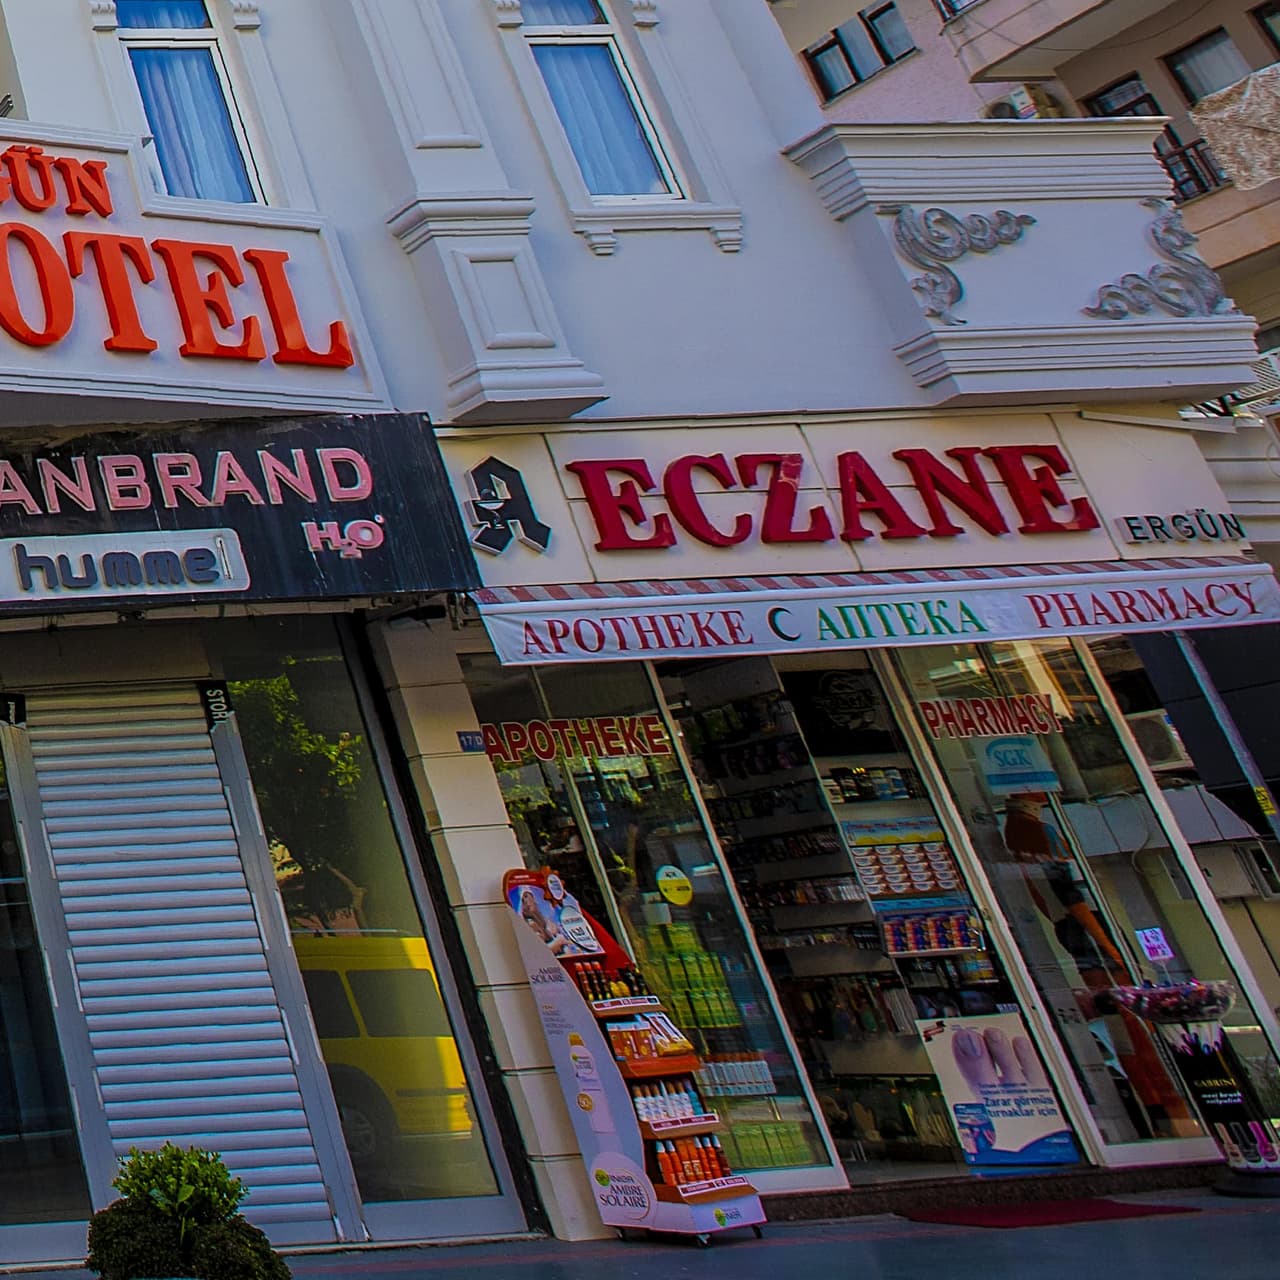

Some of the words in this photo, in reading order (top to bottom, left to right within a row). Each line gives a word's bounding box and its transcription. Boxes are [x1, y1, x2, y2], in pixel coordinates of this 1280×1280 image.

[565, 444, 1100, 552] ECZANE
[1122, 508, 1246, 544] ERGÜN
[13, 536, 235, 591] hummel
[817, 598, 990, 641] АПТЕКА
[1024, 581, 1263, 631] PHARMACY
[523, 610, 754, 656] APOTHEKE
[206, 689, 232, 723] STOR
[919, 693, 1064, 740] PHARMACY
[481, 715, 672, 763] APOTHEKE
[993, 748, 1033, 768] SGK
[600, 1194, 648, 1208] SOLAIRE
[610, 1184, 643, 1196] AMBRE
